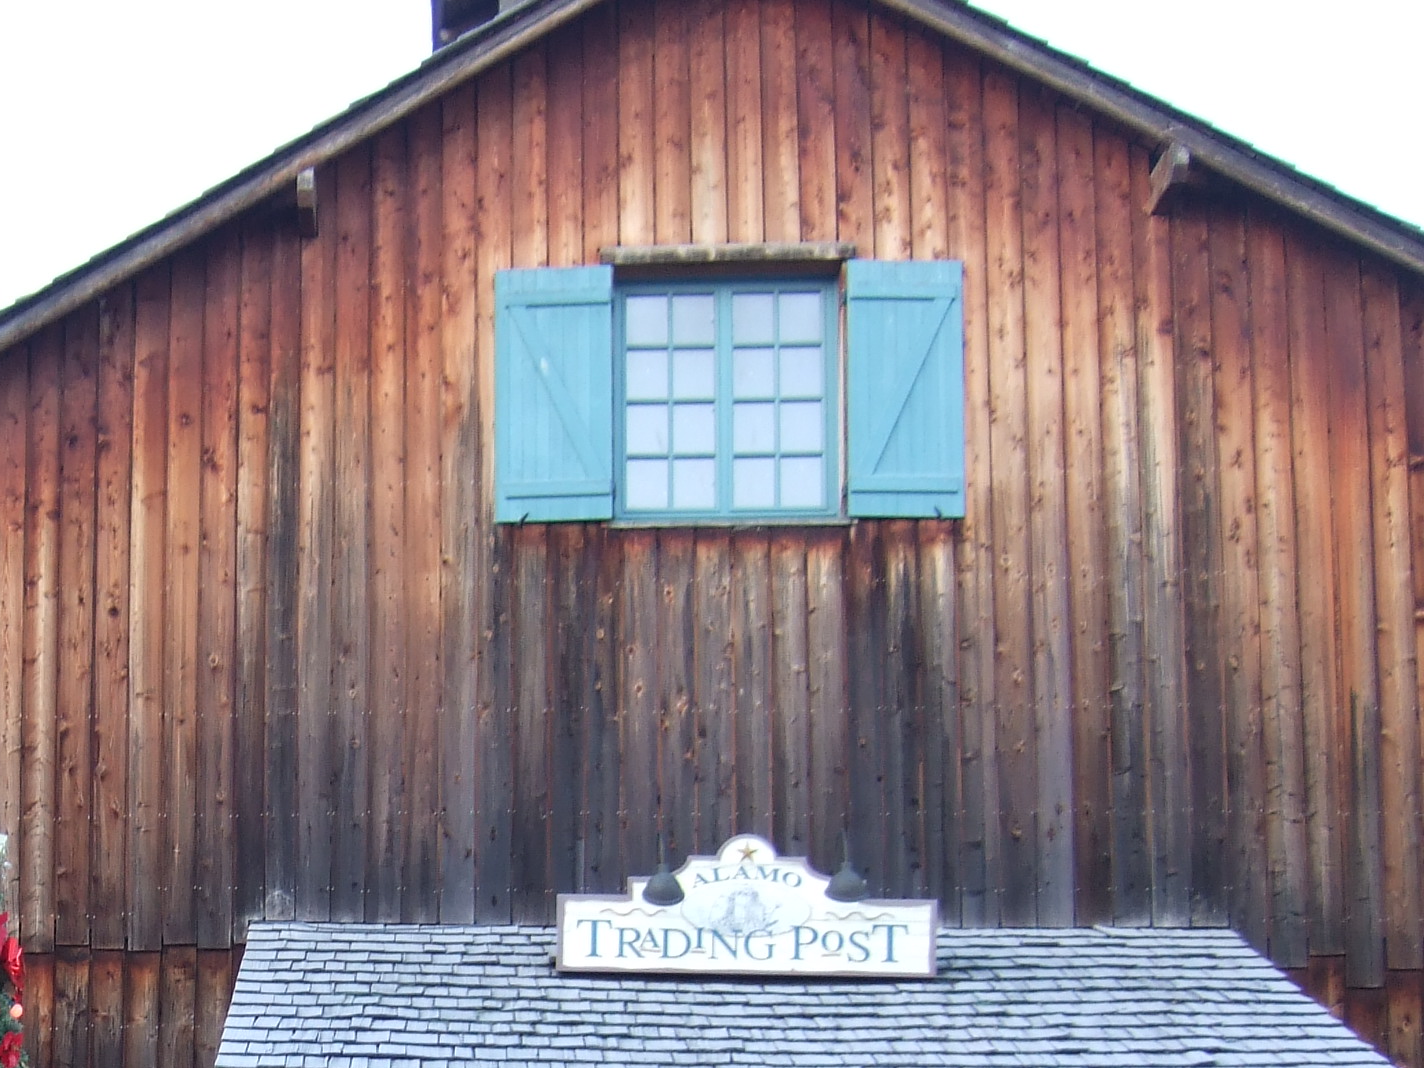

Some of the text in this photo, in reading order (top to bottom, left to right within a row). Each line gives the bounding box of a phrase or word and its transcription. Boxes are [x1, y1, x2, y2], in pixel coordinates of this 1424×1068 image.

[692, 865, 802, 889] ALAMO
[576, 919, 908, 963] TRADING POST
